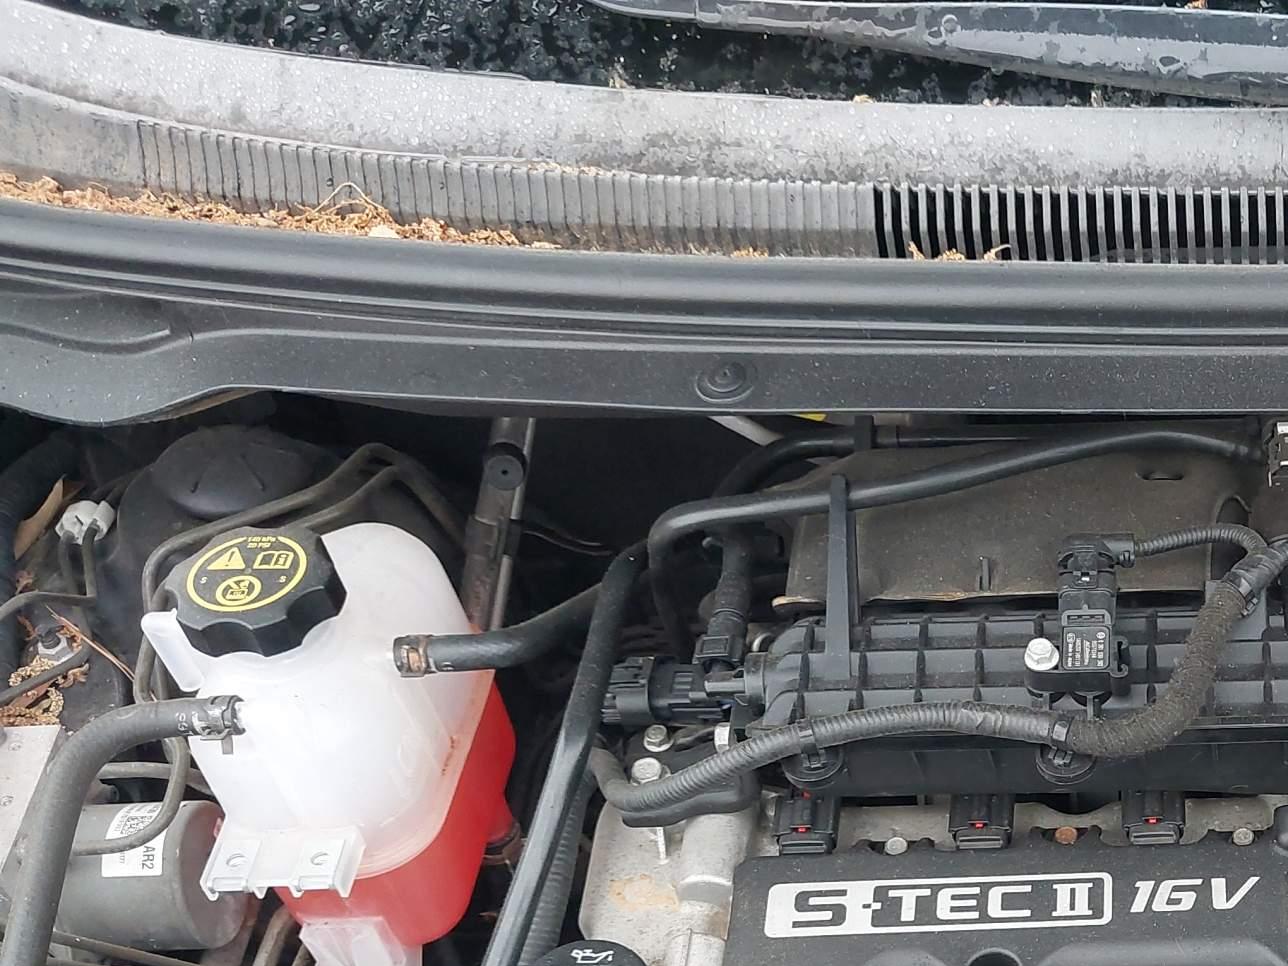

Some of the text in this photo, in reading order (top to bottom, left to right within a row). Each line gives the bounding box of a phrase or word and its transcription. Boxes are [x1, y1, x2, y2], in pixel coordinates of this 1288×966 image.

[142, 845, 156, 870] AR2
[1052, 881, 1094, 918] II
[1130, 876, 1261, 914] 16V
